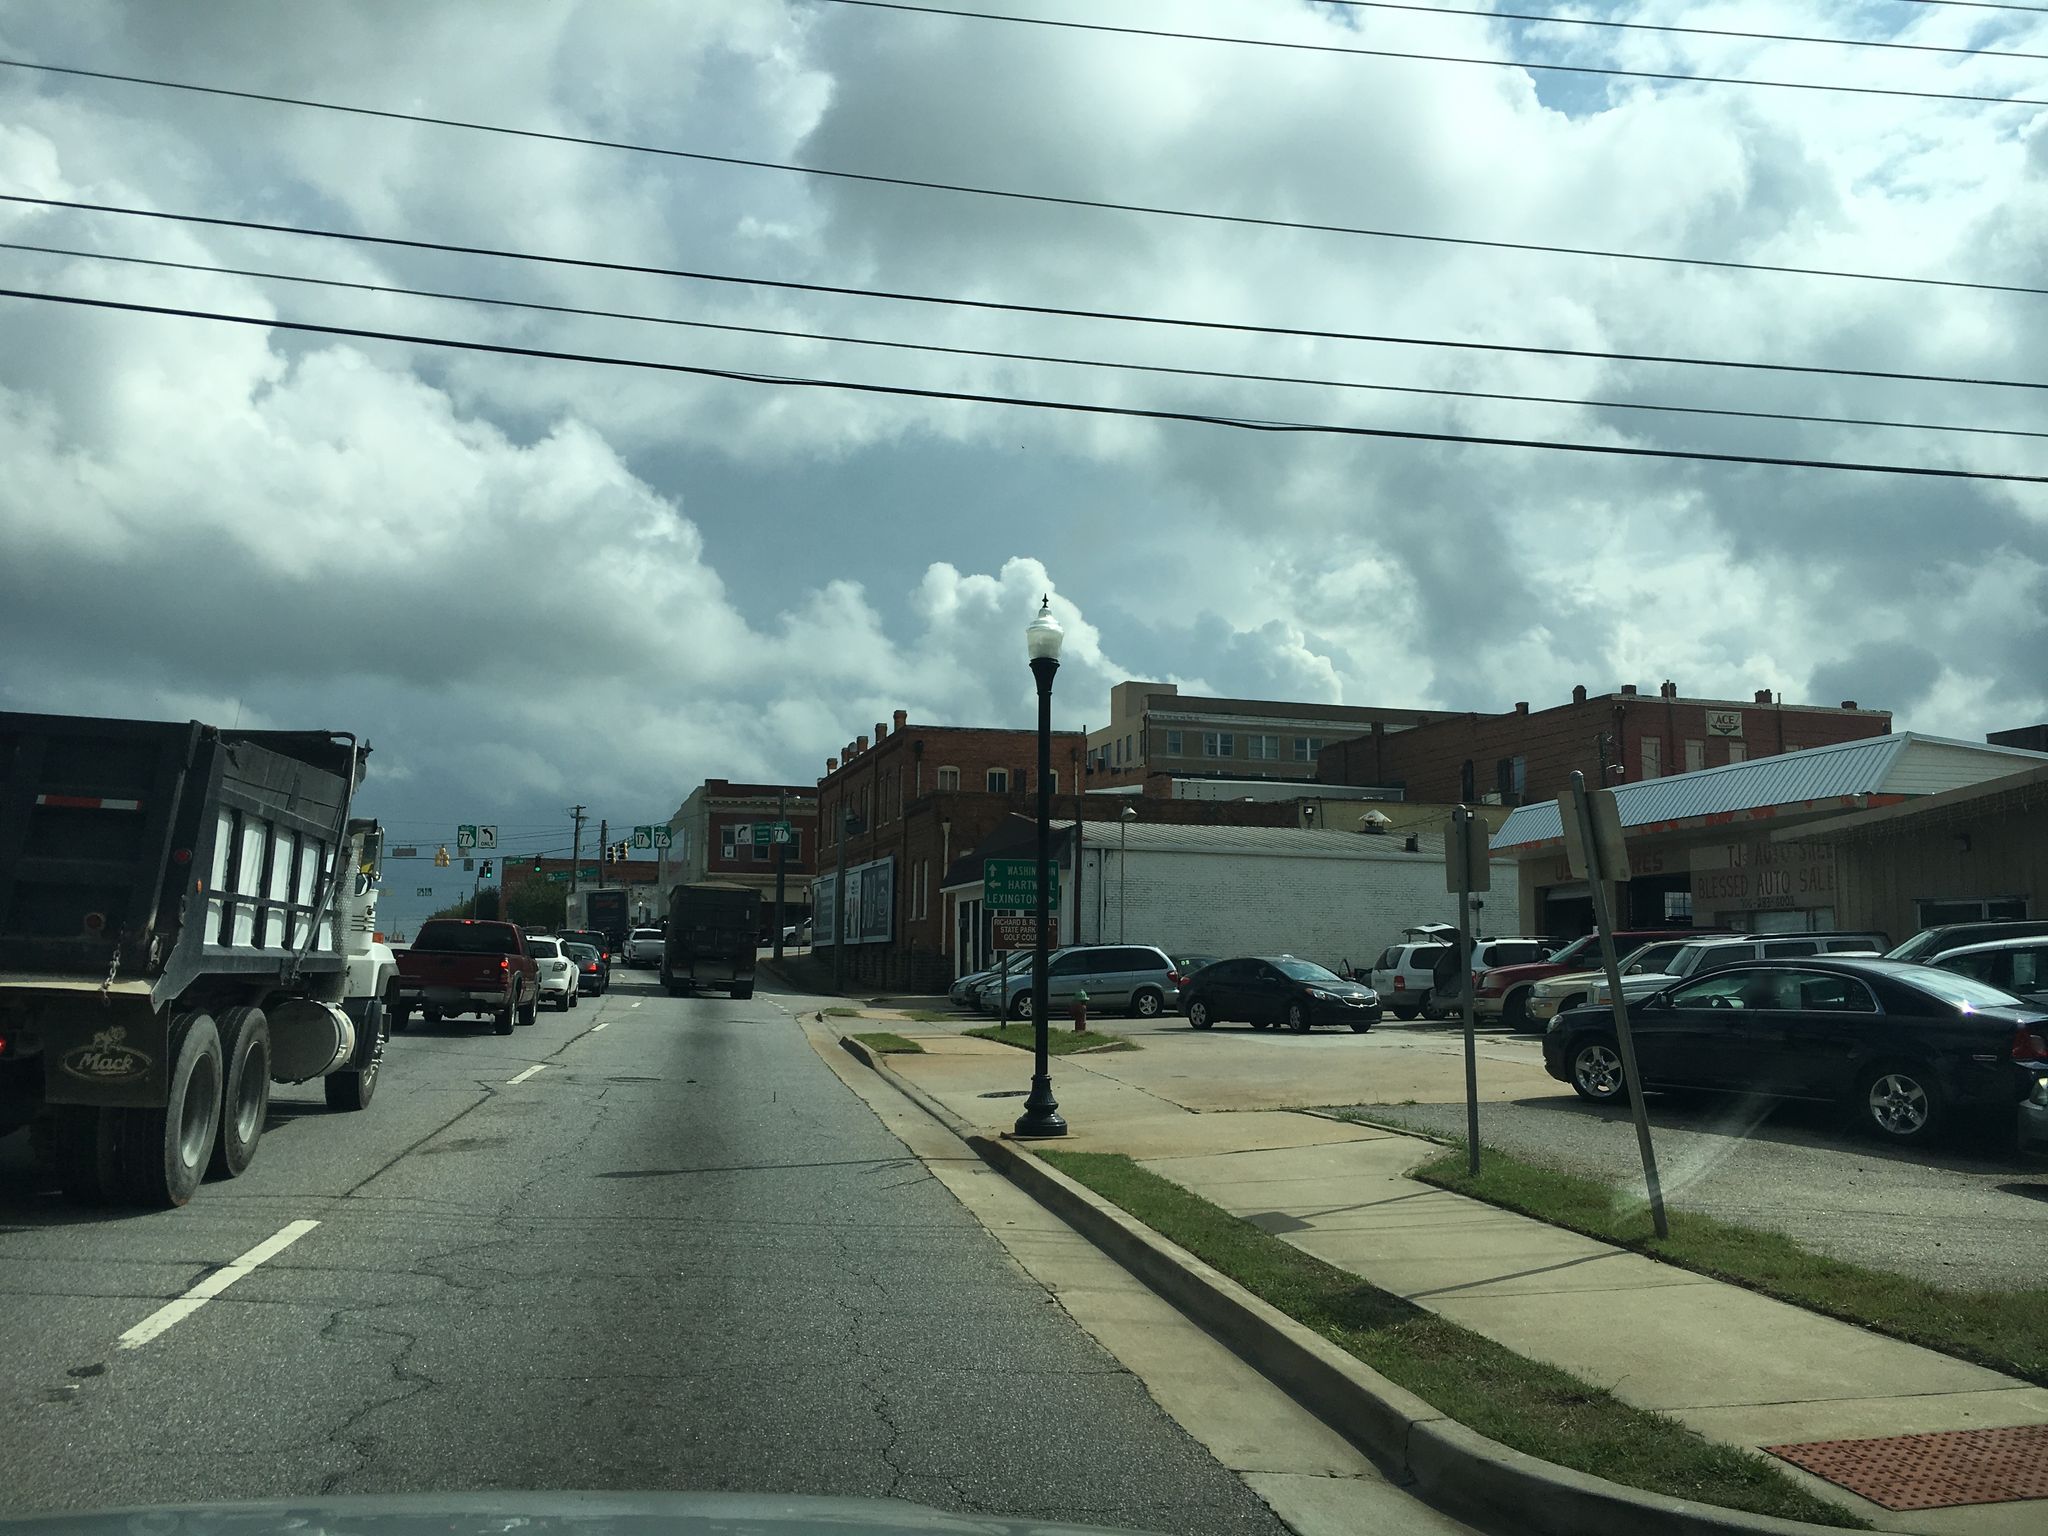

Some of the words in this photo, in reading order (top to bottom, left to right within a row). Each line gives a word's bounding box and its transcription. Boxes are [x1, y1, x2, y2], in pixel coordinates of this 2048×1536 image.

[1715, 714, 1735, 725] ACE
[459, 833, 471, 844] 77
[636, 834, 645, 845] 17
[655, 833, 667, 845] 72
[774, 829, 785, 840] 77
[1007, 865, 1057, 877] WASHINN
[1007, 880, 1056, 890] HARTWL
[1697, 874, 1749, 899] BLESSED
[1757, 869, 1791, 896] AUTO
[1000, 926, 1020, 934] STATE
[1003, 933, 1020, 942] GOLF
[76, 1052, 134, 1071] Mack
